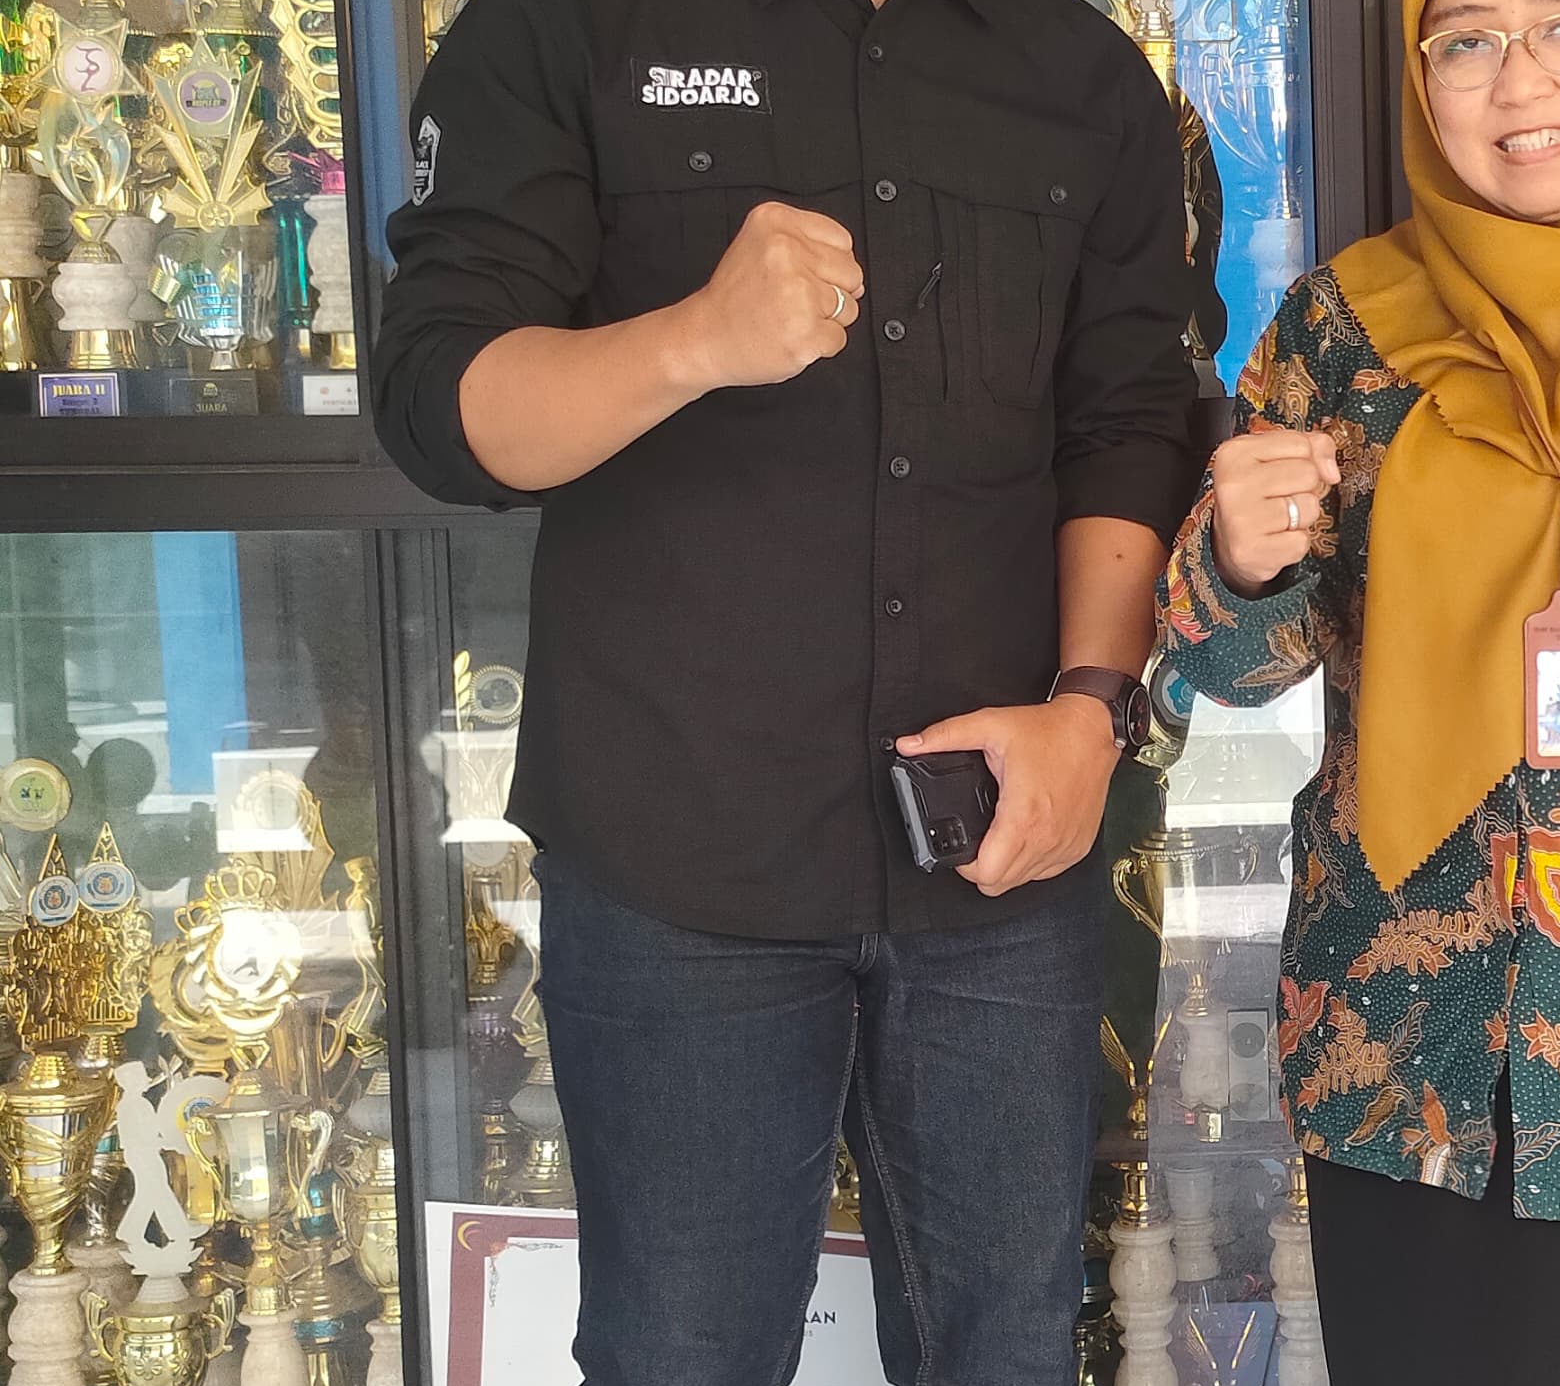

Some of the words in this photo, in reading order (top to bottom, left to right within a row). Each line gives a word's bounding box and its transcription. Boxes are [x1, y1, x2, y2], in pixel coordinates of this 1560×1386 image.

[669, 67, 753, 88] RADAR
[642, 85, 760, 107] SIDOARJO
[52, 383, 91, 398] JUARA
[96, 383, 105, 396] II
